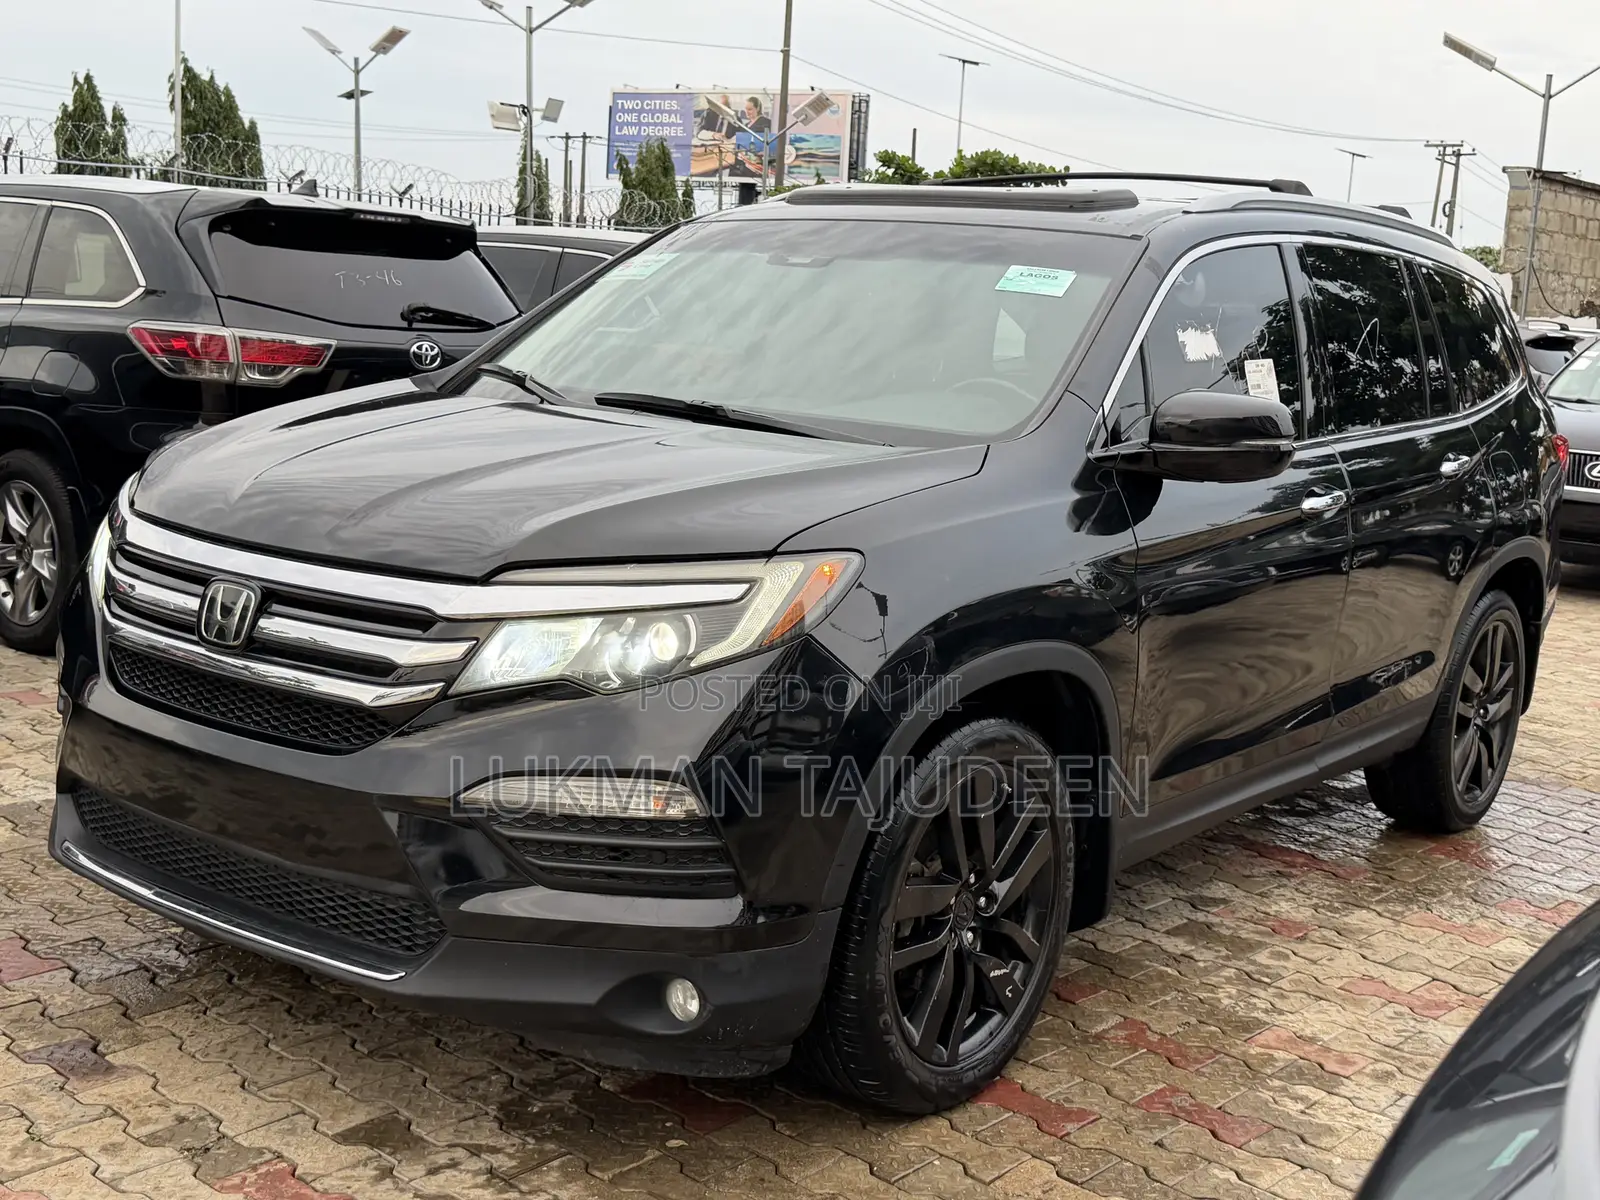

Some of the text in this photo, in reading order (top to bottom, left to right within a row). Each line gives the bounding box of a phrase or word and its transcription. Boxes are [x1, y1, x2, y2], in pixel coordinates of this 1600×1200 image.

[616, 99, 681, 111] TWO CITIES.
[615, 112, 684, 124] ONE GLOBAL
[614, 125, 687, 137] LAW DEGREE.
[1019, 271, 1060, 281] LAGOS
